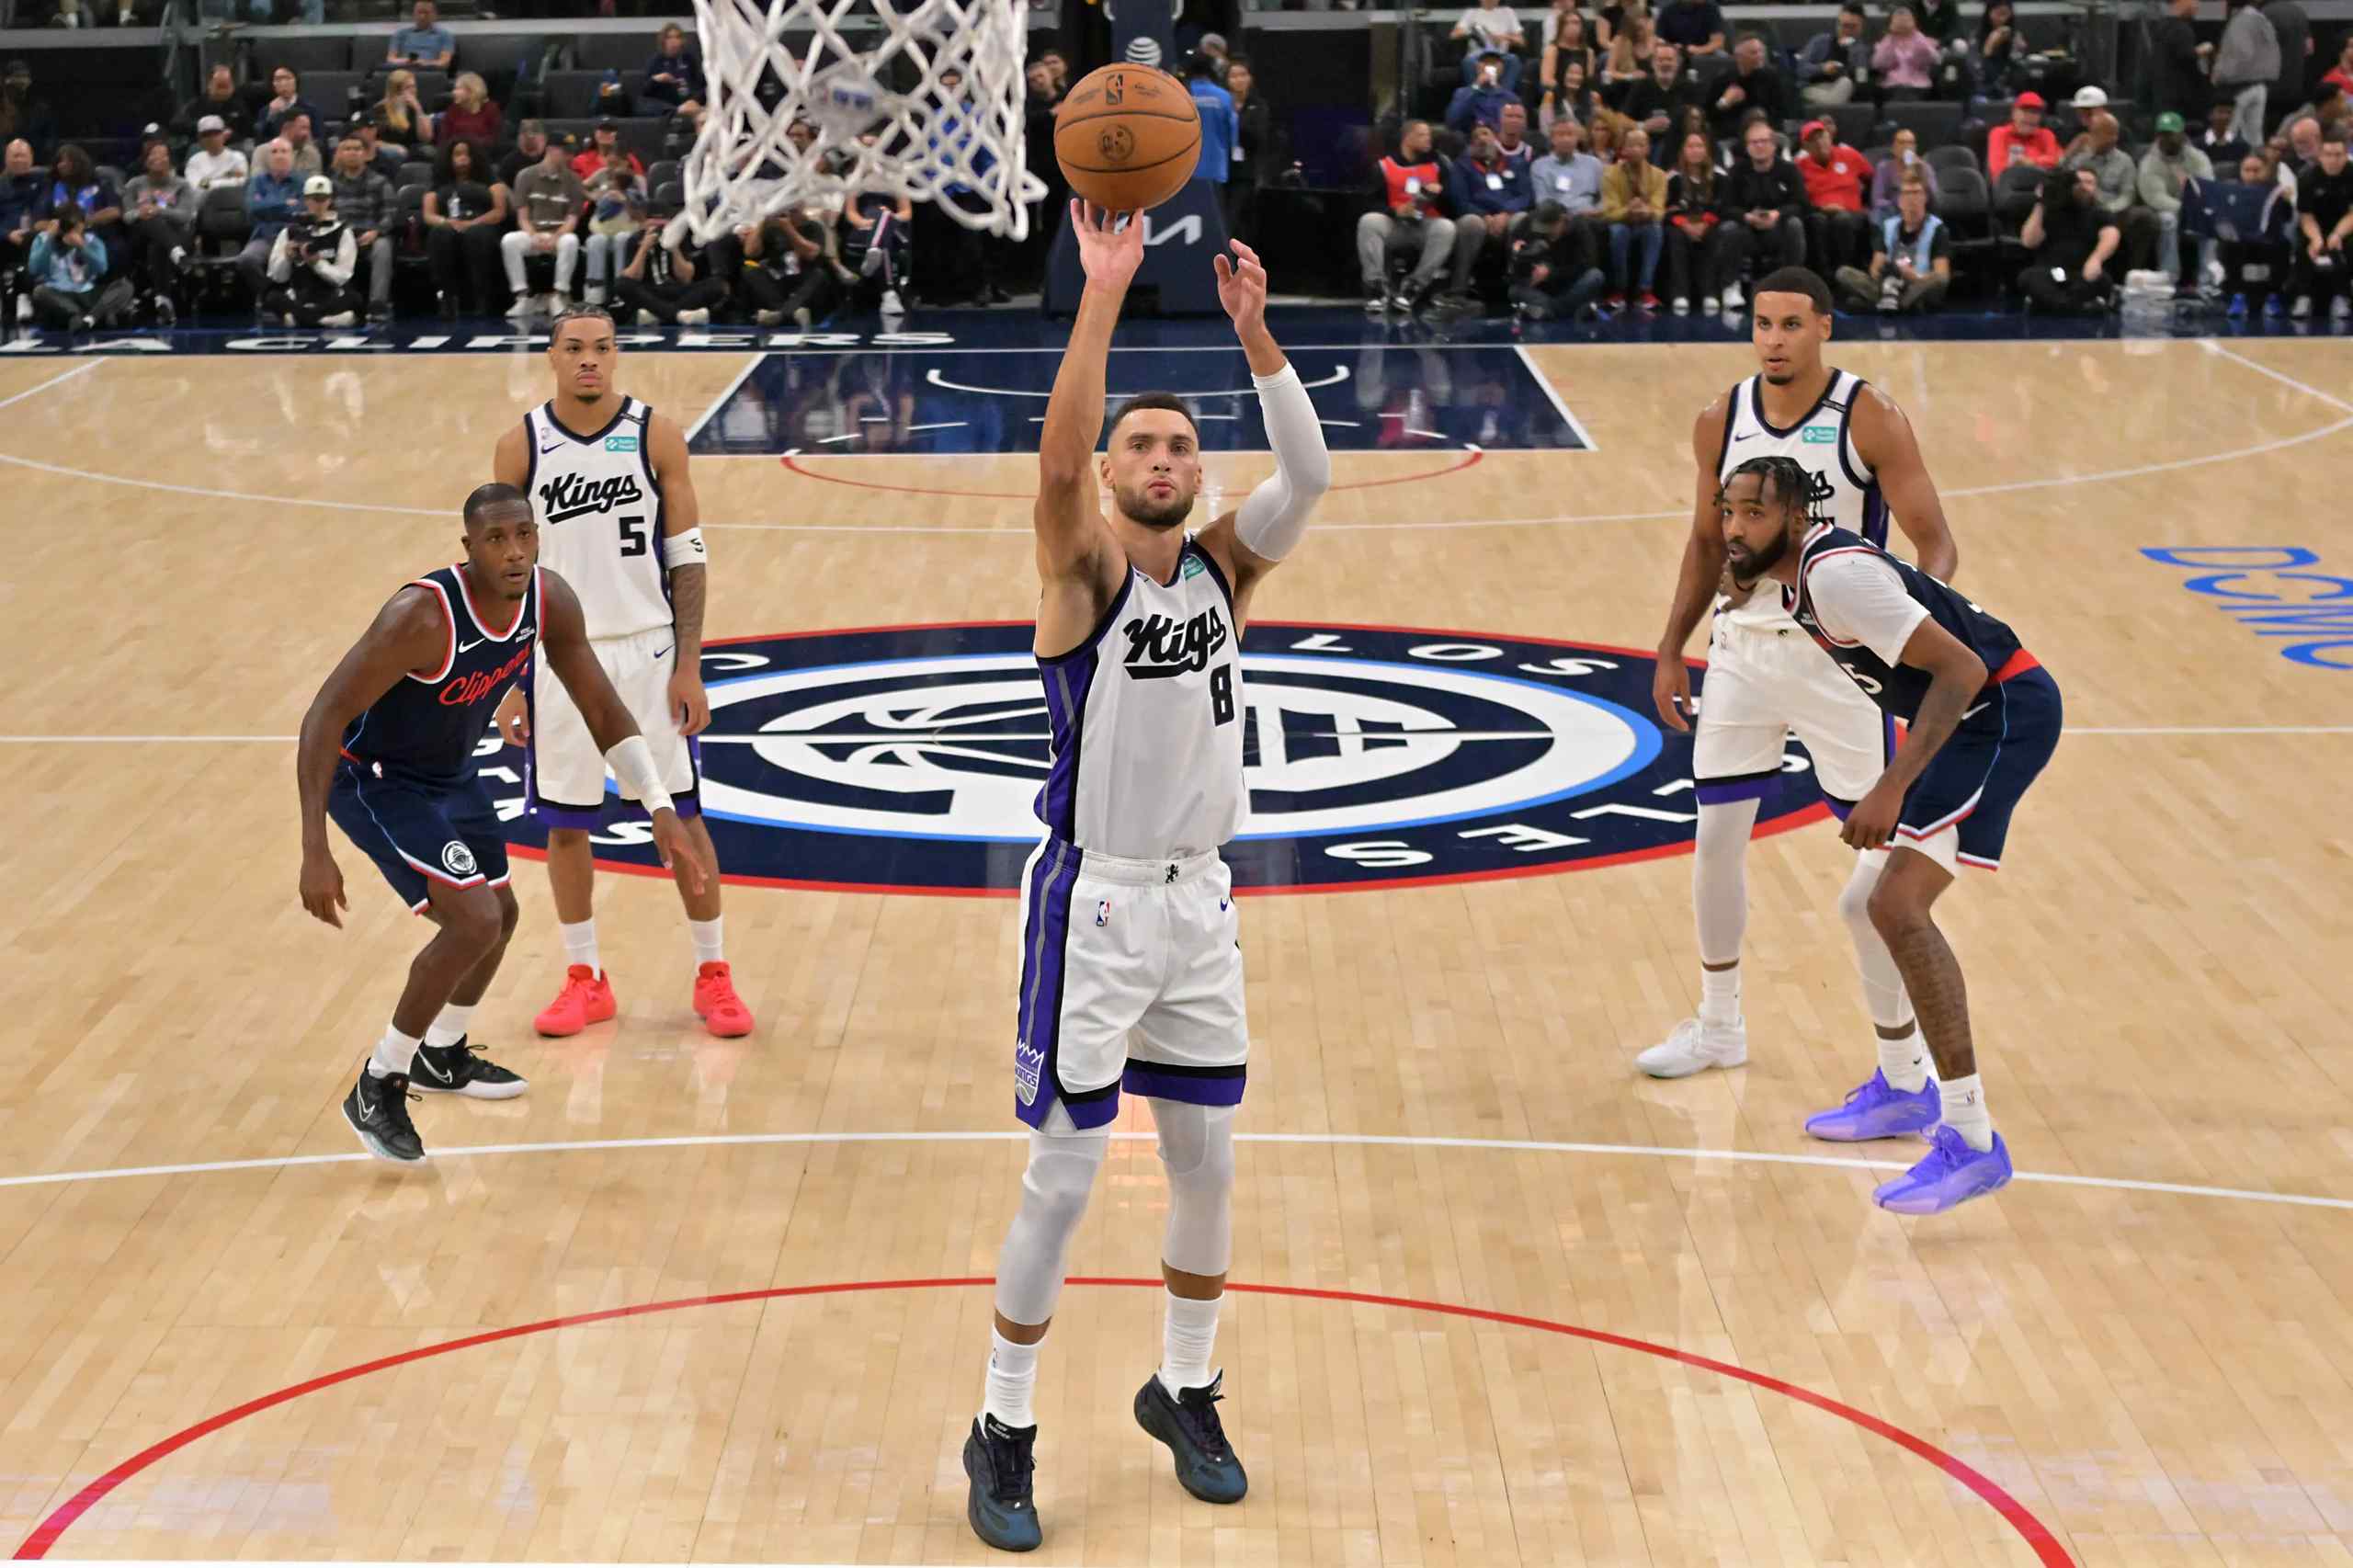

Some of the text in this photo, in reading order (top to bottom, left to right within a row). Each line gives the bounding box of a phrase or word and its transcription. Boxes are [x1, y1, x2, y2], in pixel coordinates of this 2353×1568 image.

[0, 337, 174, 352] LA
[539, 472, 642, 525] Kings
[619, 516, 647, 557] 5
[1122, 605, 1227, 680] Kigs
[1290, 633, 1620, 676] LOS
[1209, 663, 1235, 727] 8
